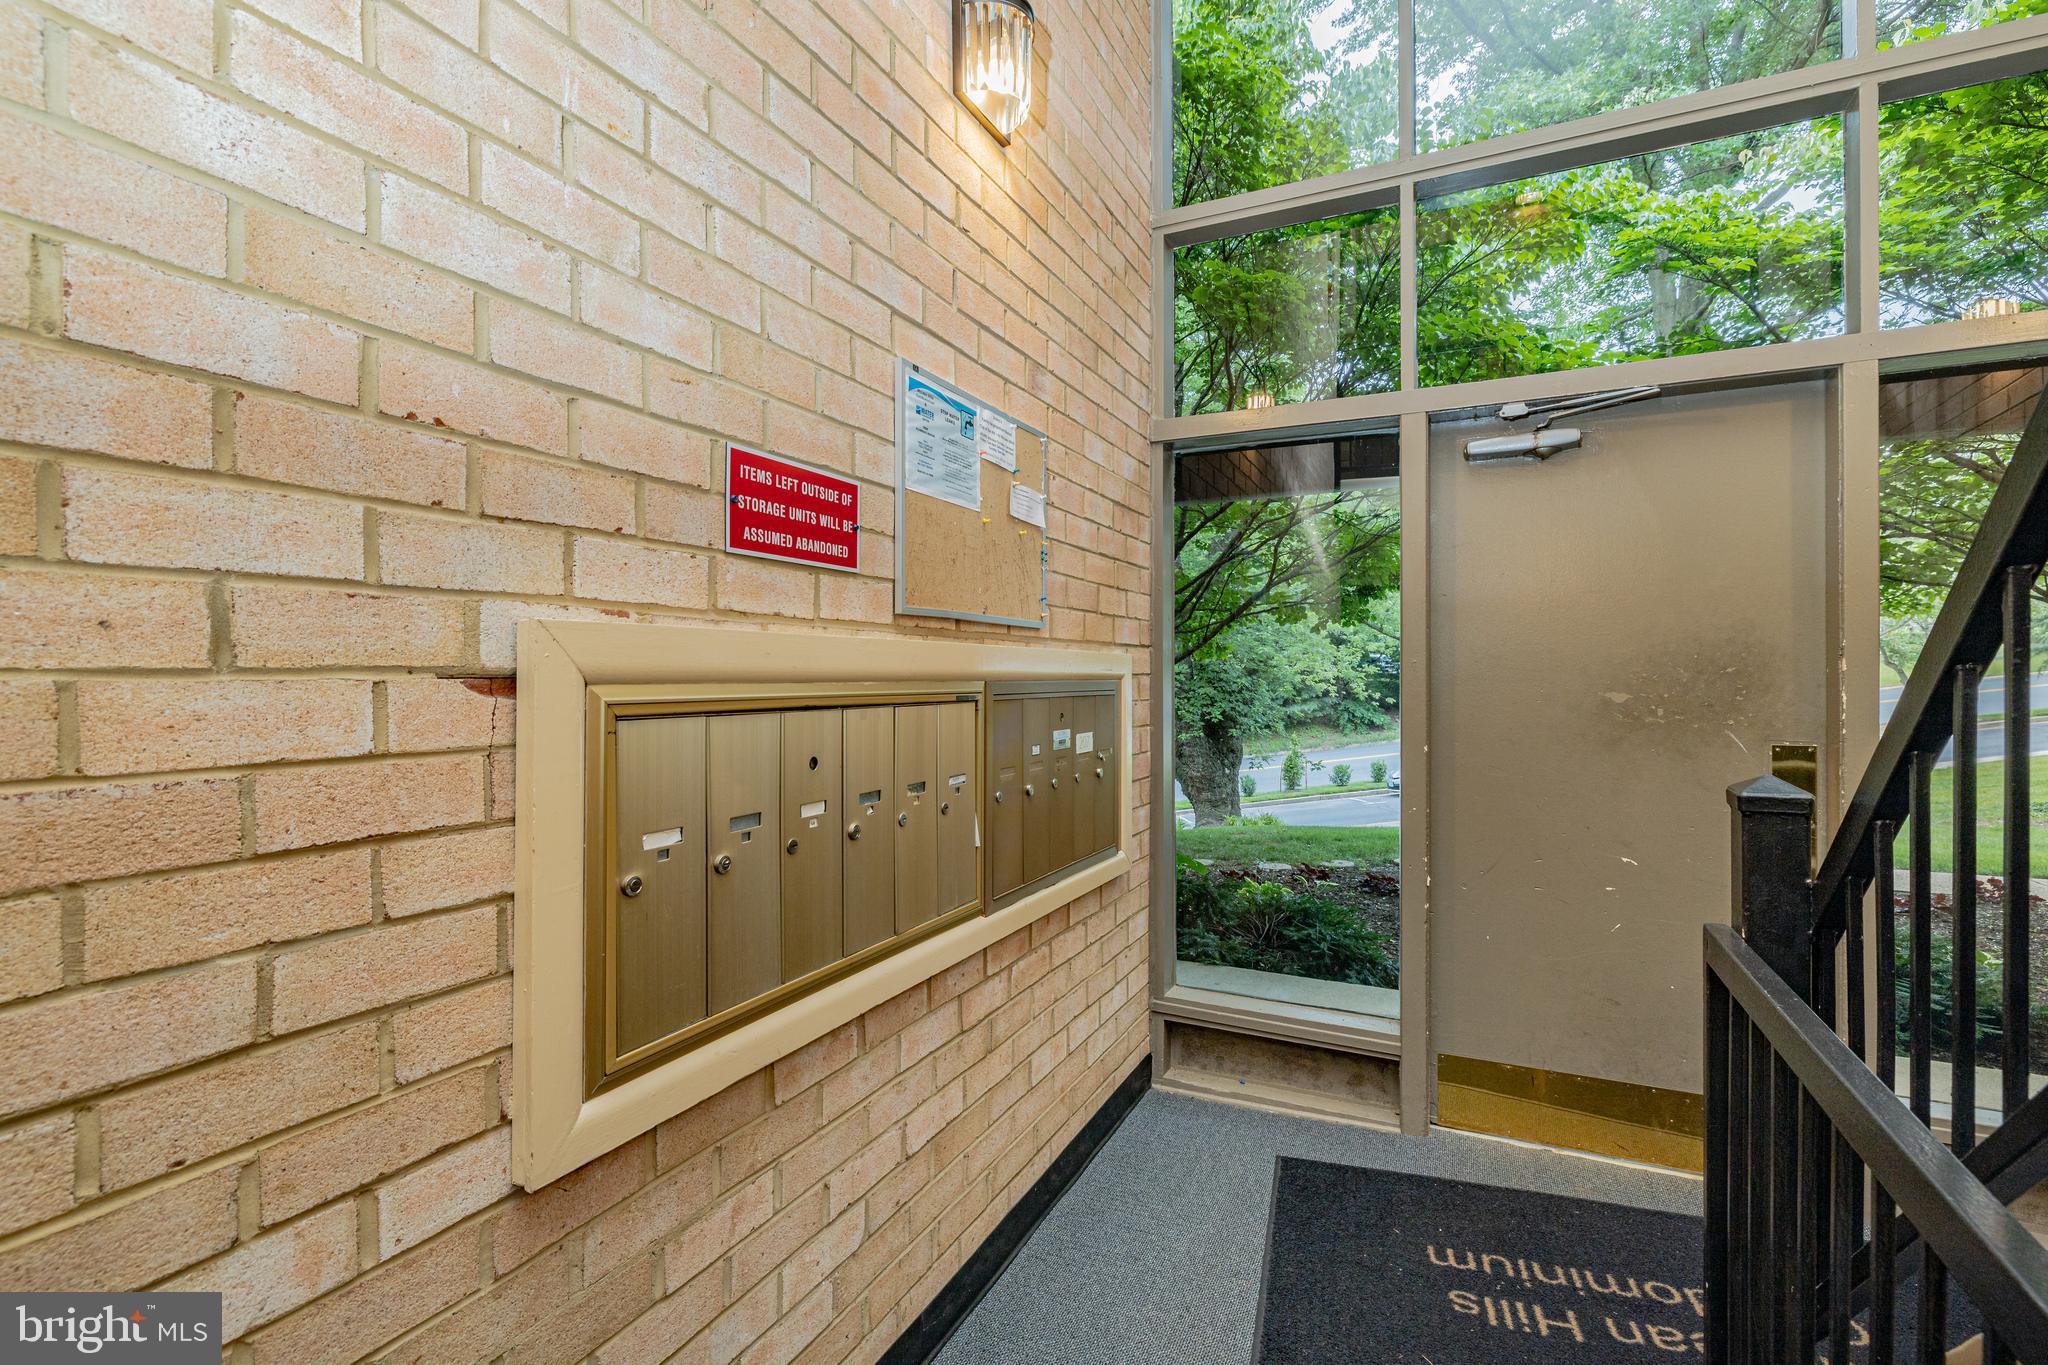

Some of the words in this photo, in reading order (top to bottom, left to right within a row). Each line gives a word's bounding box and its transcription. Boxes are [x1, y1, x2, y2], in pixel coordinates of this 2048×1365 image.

[739, 464, 773, 486] ITEMS
[775, 475, 799, 493] LEFT
[801, 482, 839, 503] OUTSIDE
[841, 493, 853, 507] OF
[737, 494, 786, 518] STORAGE
[789, 506, 817, 525] UNITS
[819, 513, 840, 531] WILL
[842, 519, 853, 533] BE
[743, 526, 793, 548] ASSUMED
[795, 537, 849, 558] ABANDONED
[1448, 1290, 1584, 1343] Hills
